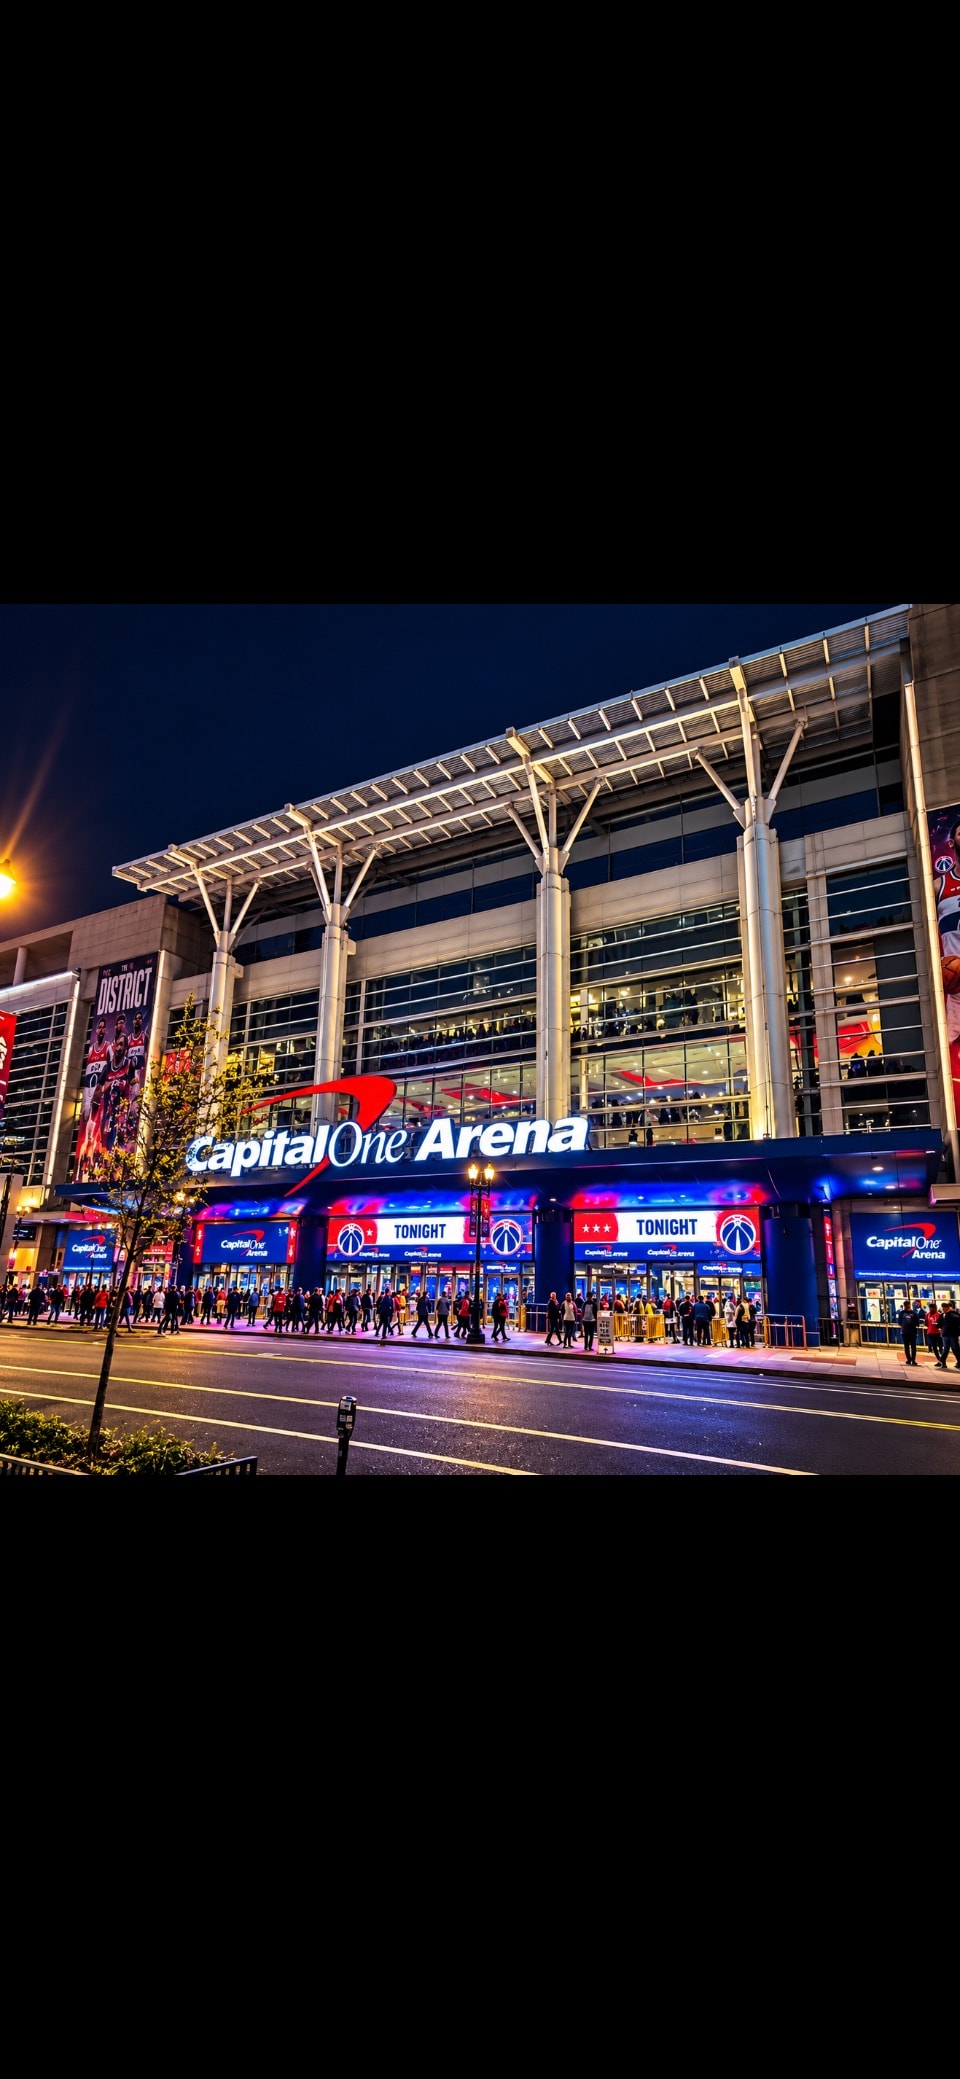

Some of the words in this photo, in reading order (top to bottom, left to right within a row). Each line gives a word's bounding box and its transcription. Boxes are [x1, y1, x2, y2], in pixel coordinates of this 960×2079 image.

[97, 967, 153, 1016] DISTRICT
[414, 1116, 589, 1161] Arena
[394, 1223, 447, 1239] TONIGHT
[636, 1219, 698, 1236] TONIGHT
[246, 1249, 268, 1257] Arena
[912, 1250, 946, 1259] Arena
